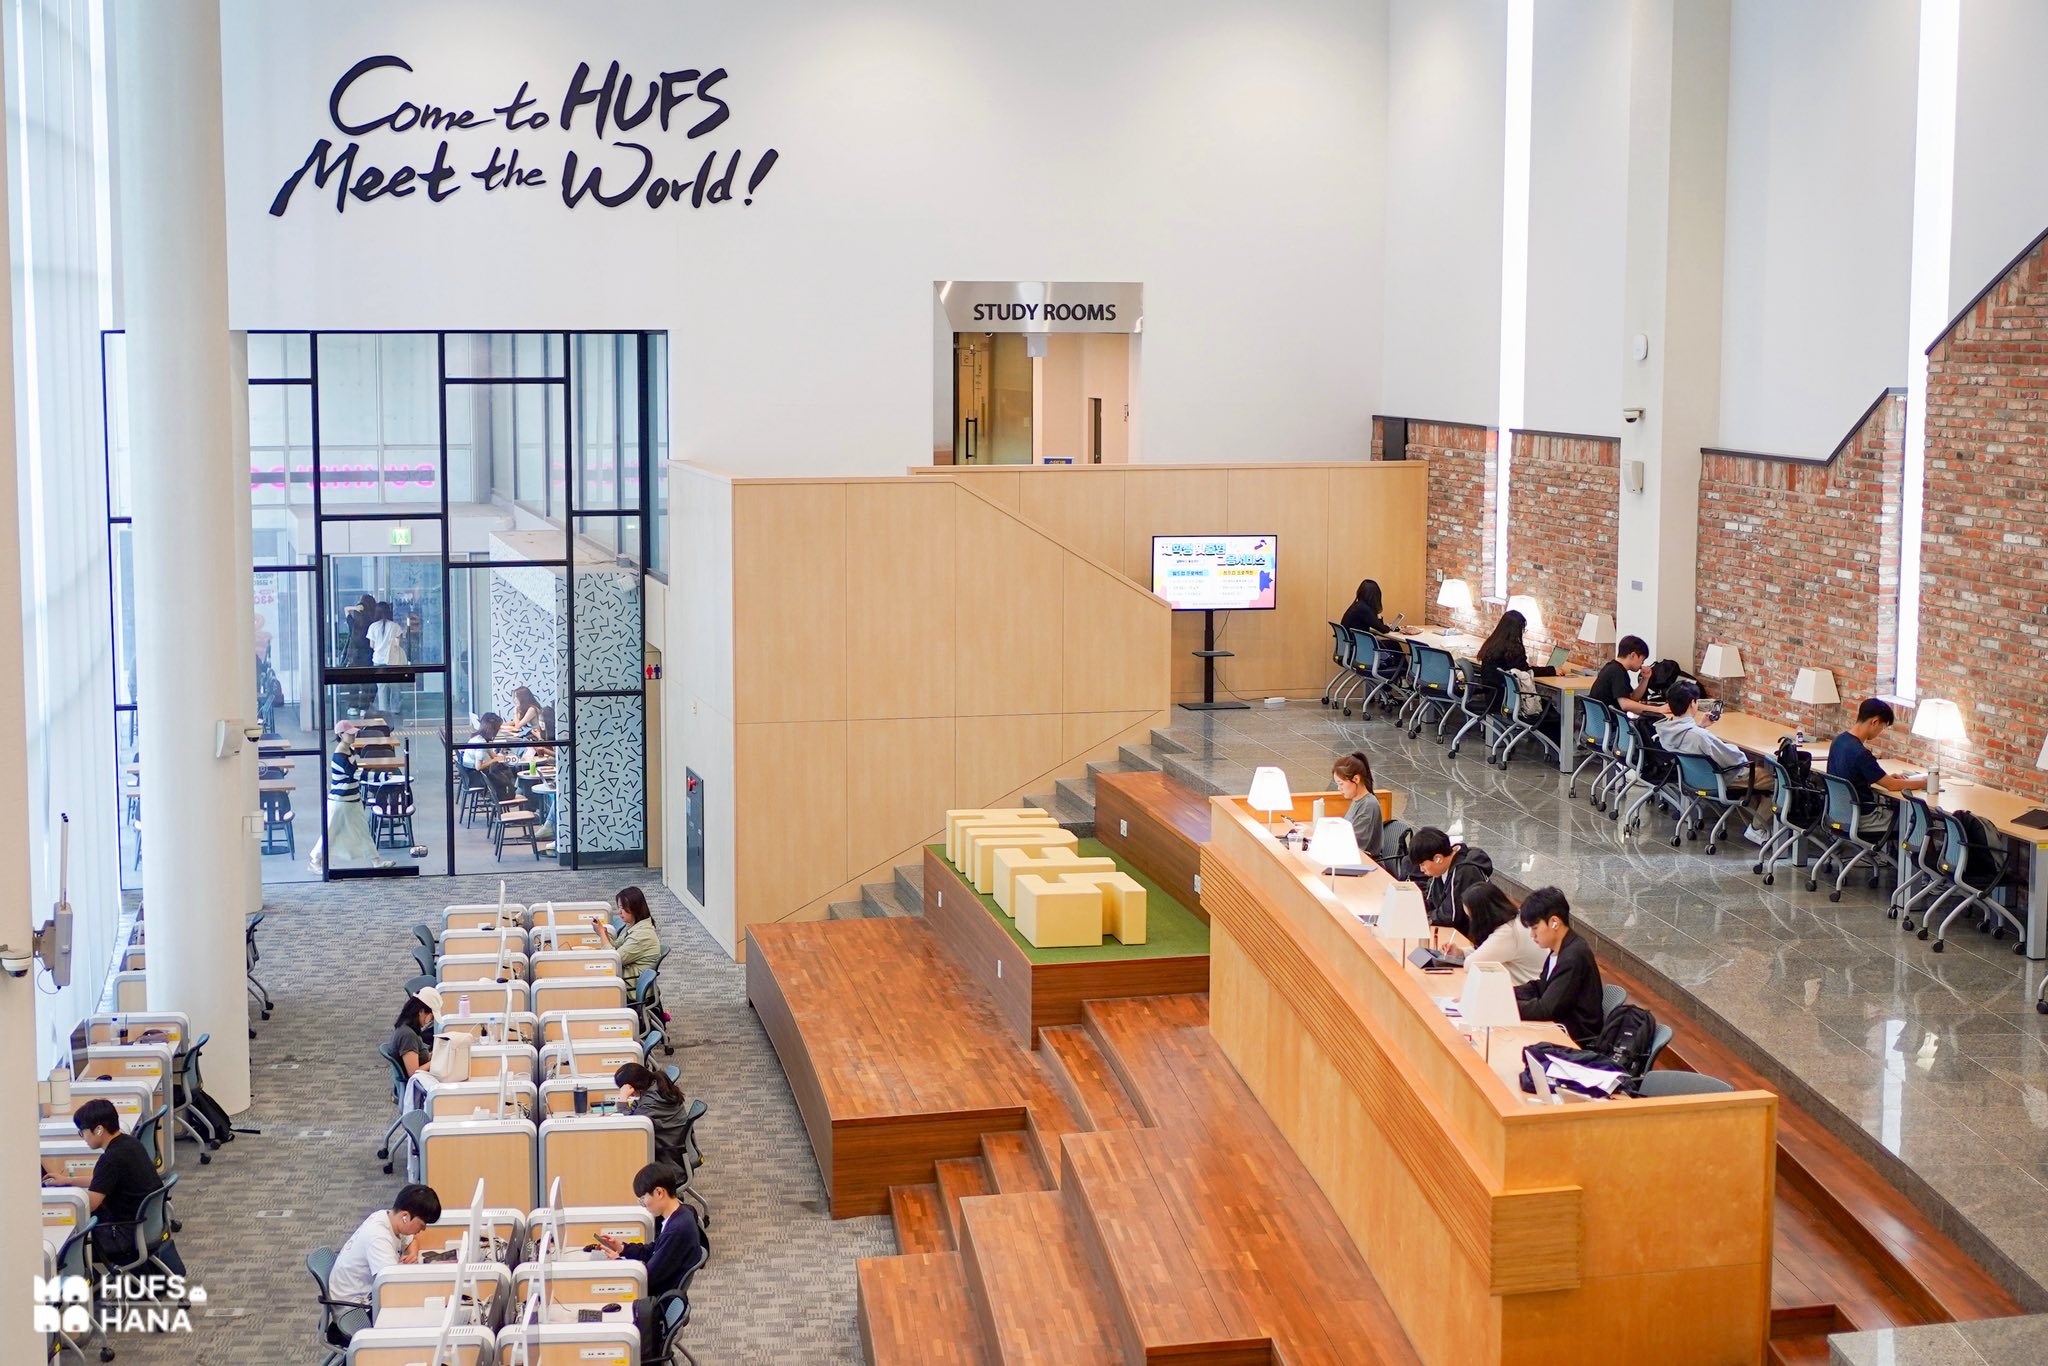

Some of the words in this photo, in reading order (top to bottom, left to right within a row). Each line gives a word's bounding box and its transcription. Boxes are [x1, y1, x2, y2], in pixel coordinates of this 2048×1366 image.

[329, 55, 494, 136] Come
[494, 81, 550, 131] to
[560, 60, 730, 140] HUFS
[268, 139, 461, 218] Meet
[470, 146, 547, 191] the
[561, 141, 779, 210] World!
[973, 303, 1039, 321] STUDY
[1043, 303, 1117, 321] ROOMS
